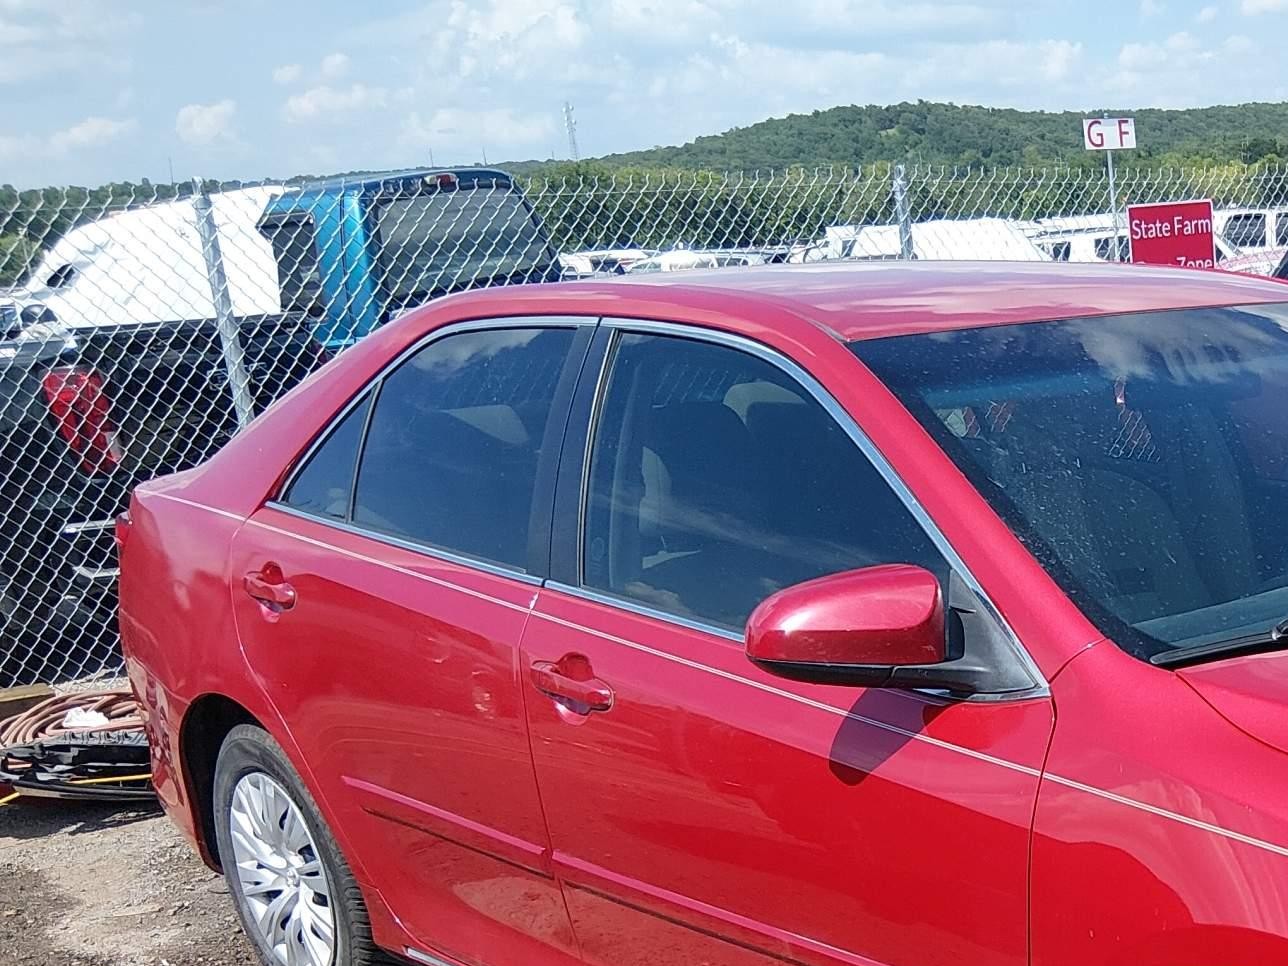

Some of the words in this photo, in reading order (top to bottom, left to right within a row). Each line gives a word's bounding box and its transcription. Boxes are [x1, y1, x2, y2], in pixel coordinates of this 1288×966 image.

[1087, 120, 1104, 147] G
[1117, 119, 1130, 147] F
[1132, 219, 1170, 240] State
[1173, 216, 1211, 236] Farm
